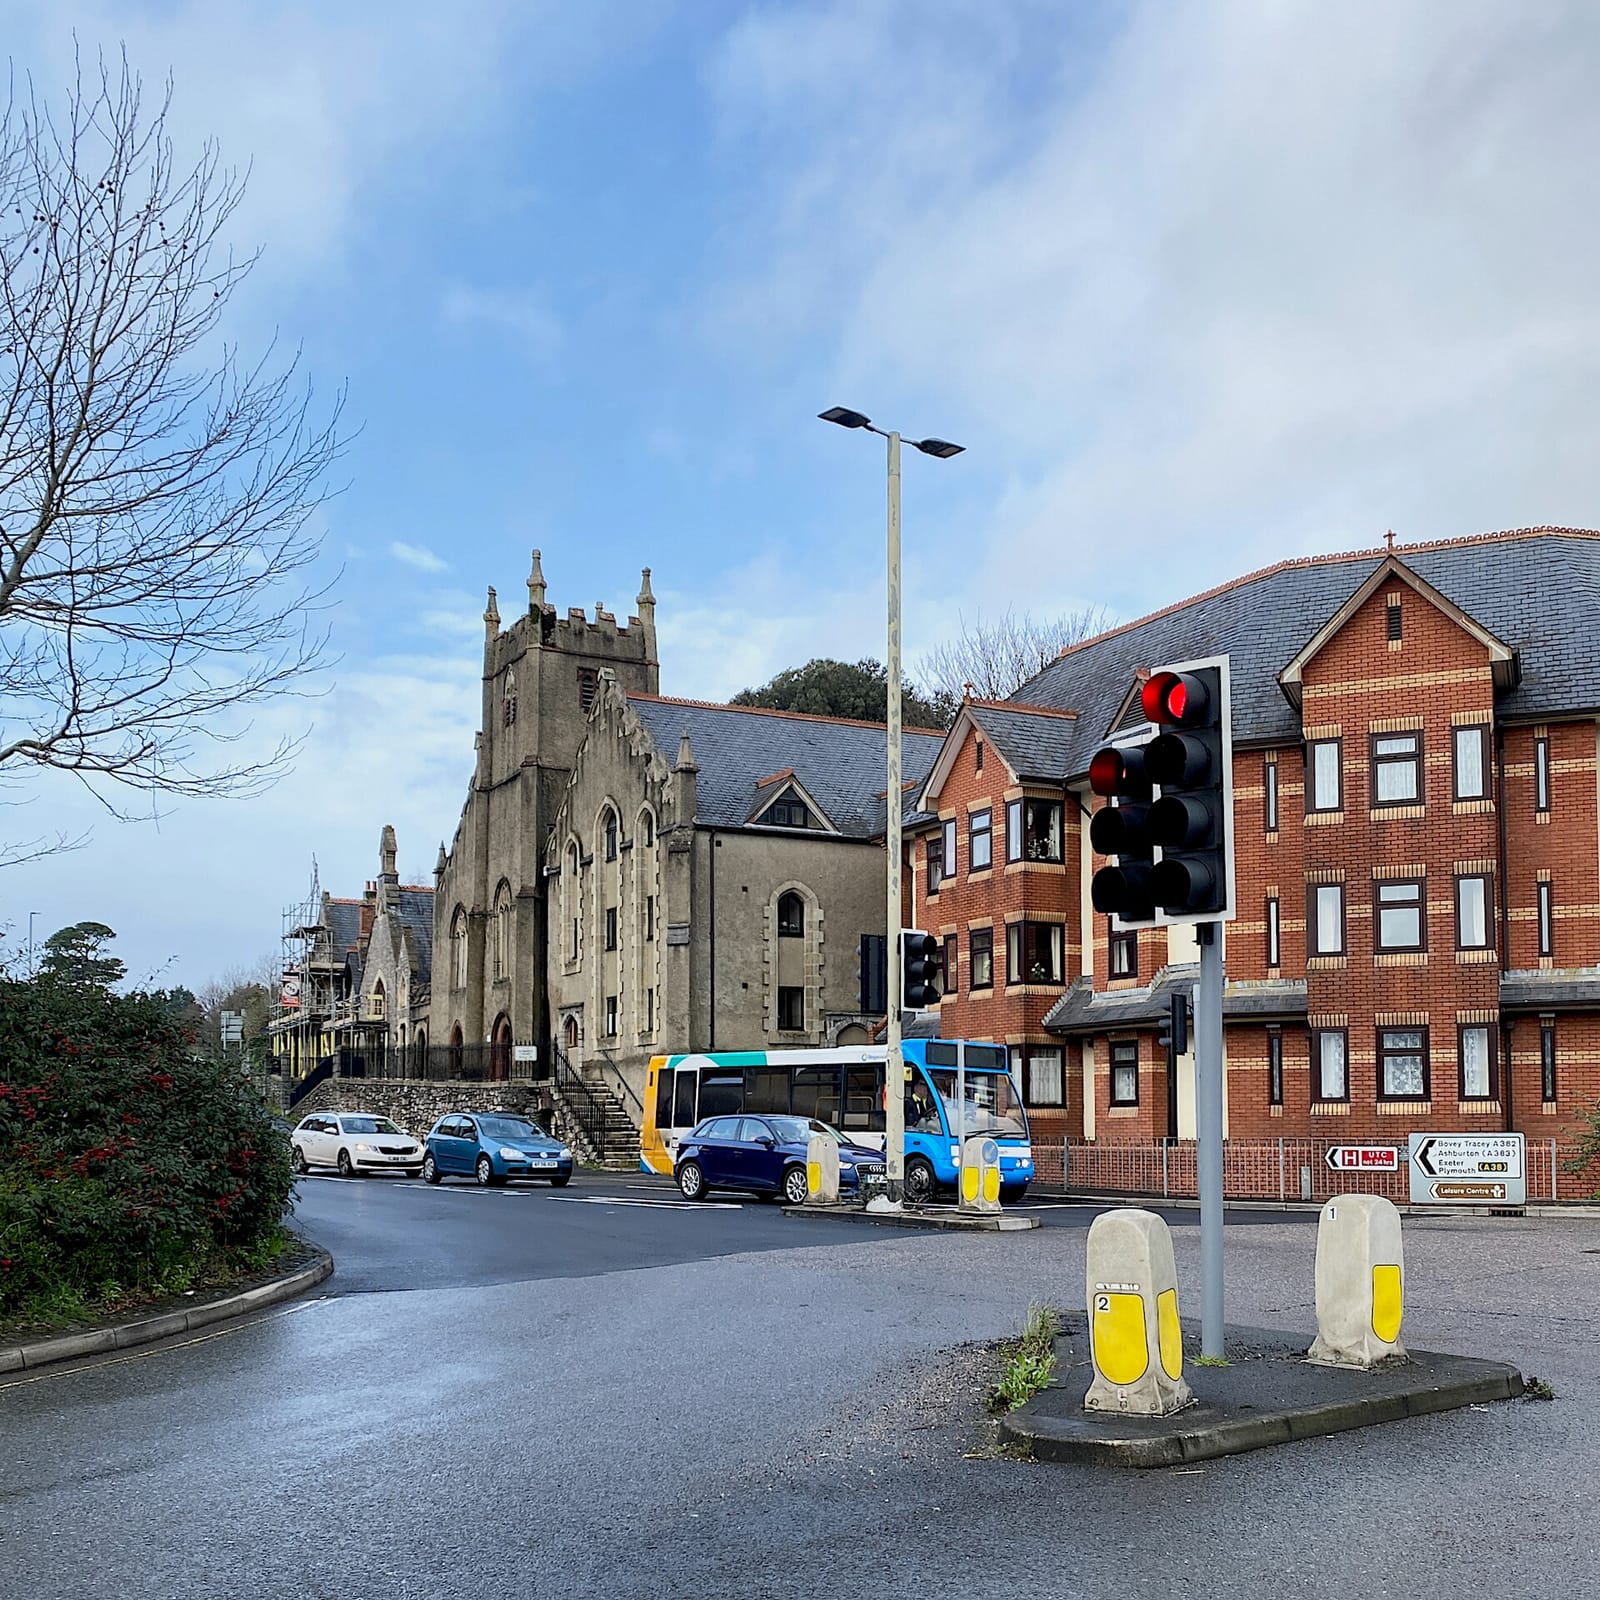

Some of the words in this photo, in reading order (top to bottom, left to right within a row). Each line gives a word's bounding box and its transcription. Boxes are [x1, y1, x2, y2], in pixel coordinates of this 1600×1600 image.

[1438, 1140, 1461, 1148] Bovey
[1464, 1140, 1490, 1148] Tracey
[1344, 1151, 1357, 1165] H
[1439, 1167, 1476, 1175] Plymouth
[1479, 1163, 1507, 1171] (A38)
[1330, 1207, 1335, 1219] 1
[1098, 1296, 1109, 1311] 2
